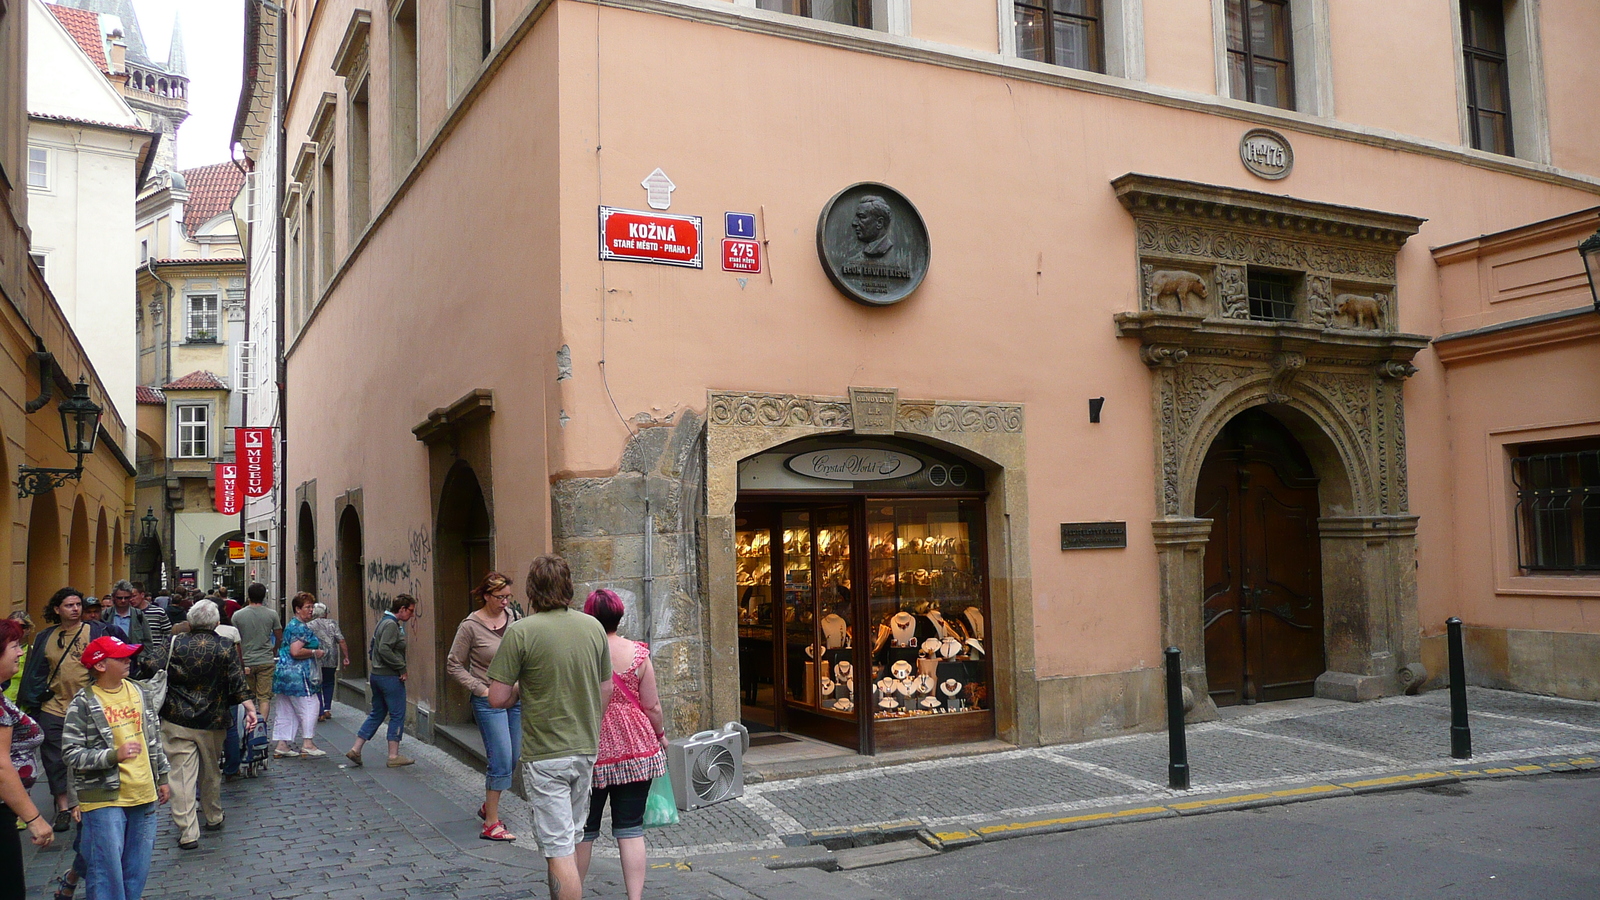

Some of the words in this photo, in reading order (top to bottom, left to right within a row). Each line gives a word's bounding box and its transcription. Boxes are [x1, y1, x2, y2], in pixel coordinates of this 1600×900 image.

[629, 222, 676, 242] KOŽNÁ
[736, 219, 743, 232] 1
[613, 238, 635, 249] STARÉ
[636, 239, 659, 251] MĚSTO
[664, 245, 686, 254] PRAHA
[687, 246, 691, 254] 1
[730, 243, 754, 257] 475
[862, 267, 887, 277] ERWIN
[889, 269, 911, 279] KISCH
[247, 449, 262, 494] MUSEUM
[812, 454, 846, 476] Crystal
[846, 454, 876, 475] World
[223, 479, 236, 513] MUSEUM
